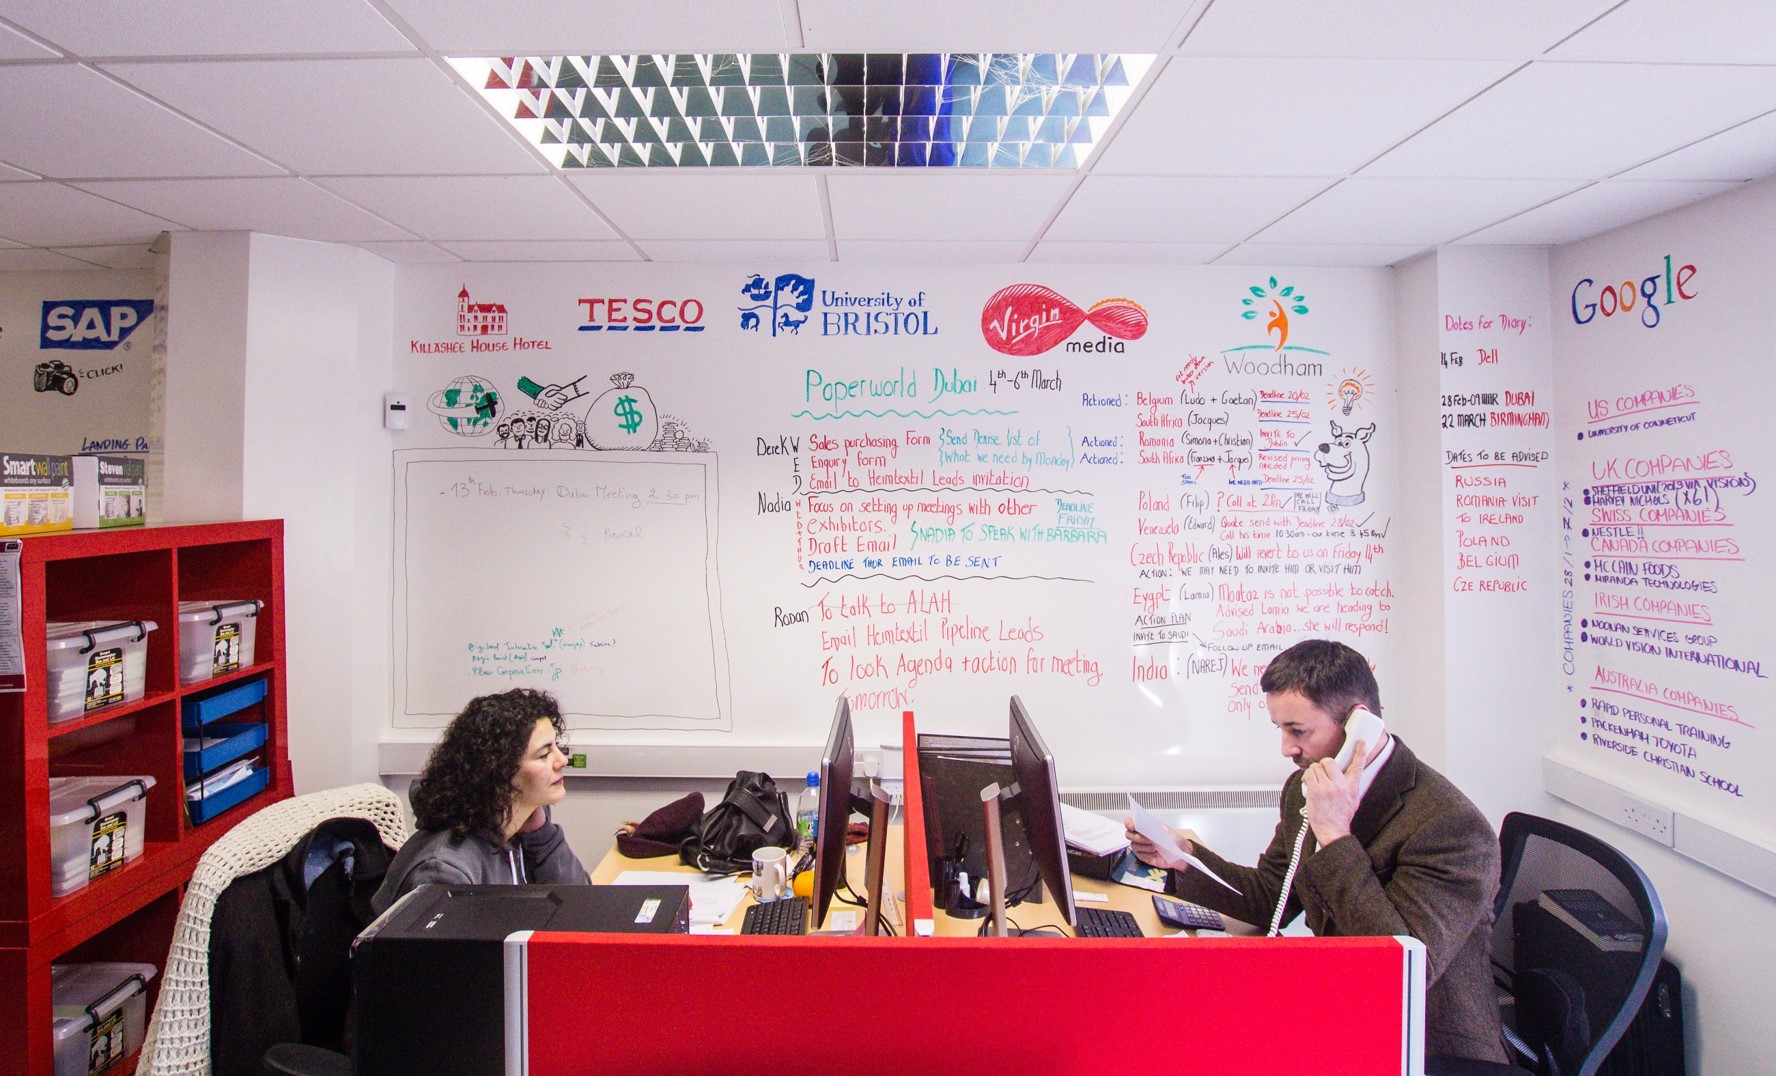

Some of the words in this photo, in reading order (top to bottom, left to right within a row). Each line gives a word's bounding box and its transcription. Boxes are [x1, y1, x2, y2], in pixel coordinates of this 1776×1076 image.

[821, 290, 904, 309] University
[907, 292, 926, 307] of
[1571, 253, 1699, 328] Google
[577, 298, 704, 324] TESCO
[46, 306, 138, 342] SAP
[822, 311, 938, 336] BRISTOL
[989, 306, 1062, 344] Virgin
[1445, 314, 1474, 331] Dates
[1478, 314, 1493, 329] for
[471, 339, 509, 352] HOUSE
[513, 337, 552, 350] HOTEL
[1066, 337, 1125, 354] media
[1223, 353, 1323, 377] Woodham
[1477, 348, 1499, 365] Dell
[806, 367, 918, 410] Paperworld
[929, 368, 978, 403] Dubai
[1030, 369, 1063, 393] March
[1504, 390, 1535, 406] DUBAI
[1136, 392, 1174, 415] Belgium
[1588, 399, 1609, 419] US
[1616, 384, 1696, 412] COMPANIES
[1457, 412, 1487, 428] MARCH
[81, 437, 130, 451] LANDING
[135, 437, 150, 450] PA
[808, 433, 839, 451] Sales
[844, 432, 899, 458] purchasing
[906, 430, 931, 445] Form
[1139, 431, 1175, 447] Romania
[857, 451, 887, 467] form
[993, 451, 1017, 464] need
[1258, 461, 1288, 470] needed
[1445, 450, 1473, 465] DATES
[1511, 449, 1549, 462] ADVISED
[1592, 458, 1622, 480] UK
[1625, 450, 1734, 479] COMPANIES
[809, 471, 837, 490] Email
[868, 468, 924, 486] Heimtextil
[932, 468, 965, 486] Leads
[972, 470, 1030, 488] invitation
[1455, 475, 1507, 488] RUSSIA
[595, 486, 641, 508] Meeting
[757, 492, 792, 515] Nadia
[1138, 490, 1170, 512] Poland
[1456, 494, 1506, 507] ROMANIA
[1512, 494, 1539, 506] VISIT
[808, 496, 834, 513] Focus
[840, 502, 853, 513] on
[859, 497, 898, 524] setting
[916, 497, 963, 525] meetings
[968, 497, 991, 516] with
[998, 497, 1037, 516] other
[1058, 513, 1095, 527] FRIDAY
[1479, 513, 1524, 524] IRELAND
[1591, 507, 1632, 523] SWISS
[1639, 506, 1726, 523] COMPANIES
[1249, 517, 1271, 528] send
[1273, 517, 1292, 528] with
[920, 527, 956, 543] NADIA
[978, 524, 1015, 542] SPEAK
[1019, 524, 1045, 541] WITH
[1046, 528, 1107, 544] BARBARA
[1220, 530, 1235, 540] Call
[1253, 529, 1271, 539] time
[1456, 530, 1510, 548] POLAND
[808, 535, 848, 556] Draft
[857, 534, 897, 553] Email
[1168, 542, 1204, 565] Republic
[1332, 542, 1362, 562] Friday
[1591, 537, 1648, 553] CANADA
[1652, 538, 1740, 554] COMPANIES
[808, 558, 854, 573] DEADLINE
[863, 556, 883, 569] THUR
[891, 557, 923, 567] EMAIL
[945, 554, 961, 567] BE
[965, 555, 1002, 569] SENT
[1199, 566, 1215, 576] MAY
[1219, 565, 1239, 577] NEED
[1257, 564, 1280, 575] INVITE
[1318, 563, 1341, 574] VISIT
[1343, 564, 1362, 575] HIM
[1457, 553, 1520, 570] BELGIUM
[1642, 562, 1680, 579] FOODS
[1453, 577, 1474, 592] CZE
[1479, 577, 1528, 592] REPUBLIC
[1594, 574, 1638, 586] MIRANDA
[1642, 577, 1718, 593] TECHNOLOGIES
[1280, 583, 1298, 599] not
[1305, 582, 1344, 605] possible
[1216, 604, 1254, 617] Advised
[1260, 603, 1290, 617] Lamia
[1313, 605, 1330, 615] are
[1337, 602, 1372, 623] heading
[1594, 592, 1629, 610] IRISH
[1634, 596, 1712, 622] COMPANIES
[1135, 614, 1167, 626] ACTION
[1171, 612, 1192, 624] PLAN
[821, 625, 857, 652] Email
[866, 618, 928, 646] Heimtextil
[940, 615, 991, 643] Pipeline
[999, 616, 1044, 643] Leads
[1213, 621, 1248, 640] Saudi
[1324, 619, 1341, 633] will
[1344, 618, 1389, 638] respond!
[1591, 619, 1630, 634] NOONAN
[1632, 625, 1680, 643] SERVICES
[1685, 634, 1718, 647] GROUP
[1256, 643, 1283, 651] EMAIL
[1590, 634, 1623, 648] WORLD
[1625, 640, 1661, 655] VISION
[1665, 647, 1768, 679] INTERNATIONAL
[821, 655, 839, 687] To
[896, 648, 953, 689] Agenda
[1026, 647, 1045, 675] for
[1051, 649, 1103, 686] meeting
[1230, 682, 1260, 697] Send
[1594, 665, 1658, 695] AUSTRALIA
[1663, 687, 1739, 721] COMPANIES
[1622, 708, 1673, 731] PERSONAL
[1676, 723, 1731, 749] TRAINING
[1652, 735, 1697, 759] TOYOTA
[1592, 733, 1638, 757] RIVERSIDE
[1643, 750, 1696, 779] CHRISTIAN
[1699, 770, 1744, 798] SCHOOL
